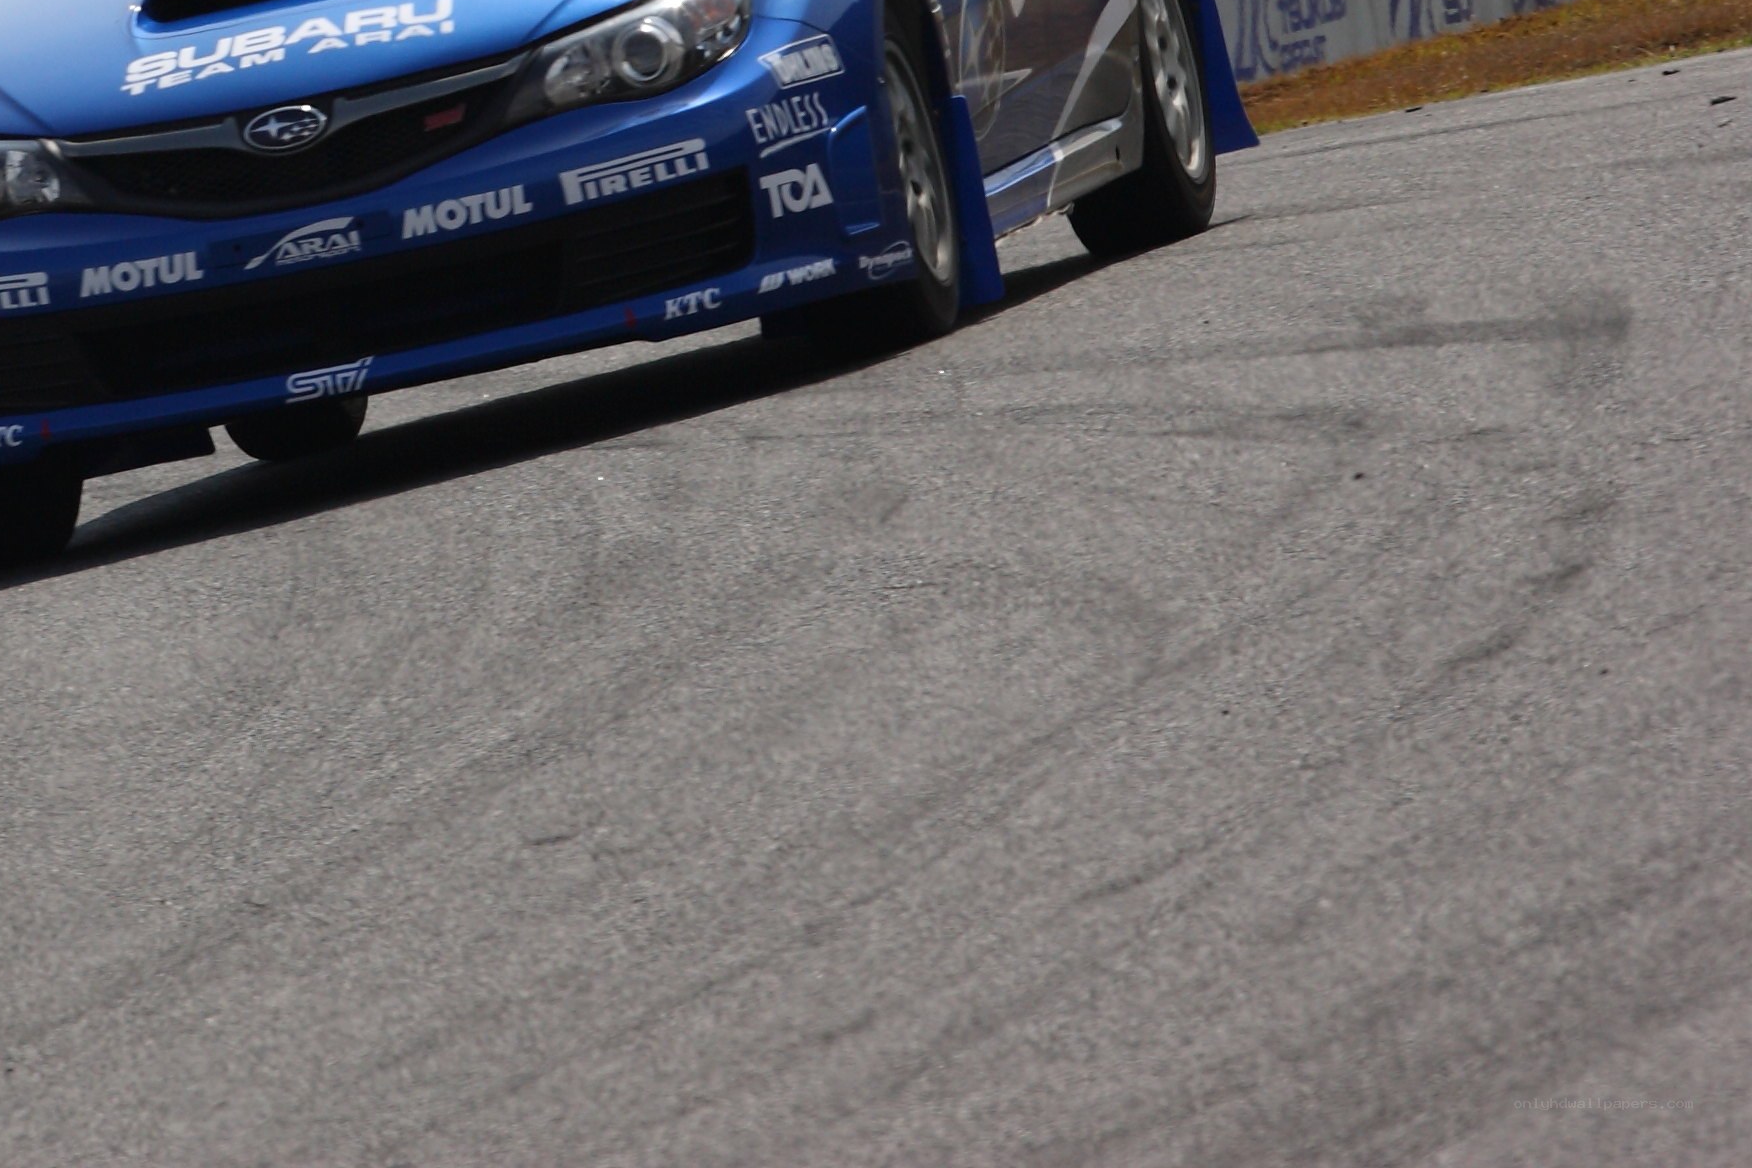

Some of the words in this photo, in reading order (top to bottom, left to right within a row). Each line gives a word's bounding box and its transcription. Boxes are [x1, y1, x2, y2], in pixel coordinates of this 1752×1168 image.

[120, 48, 286, 95] TEAM
[308, 20, 455, 55] ARAI
[746, 92, 828, 144] ENDLESS
[559, 138, 711, 205] PIRELLI
[759, 162, 834, 219] TOA
[401, 184, 533, 239] MOTUL
[275, 230, 361, 261] ARAI
[787, 258, 837, 285] WORK
[81, 251, 204, 298] MOTUL
[664, 287, 722, 321] KTC
